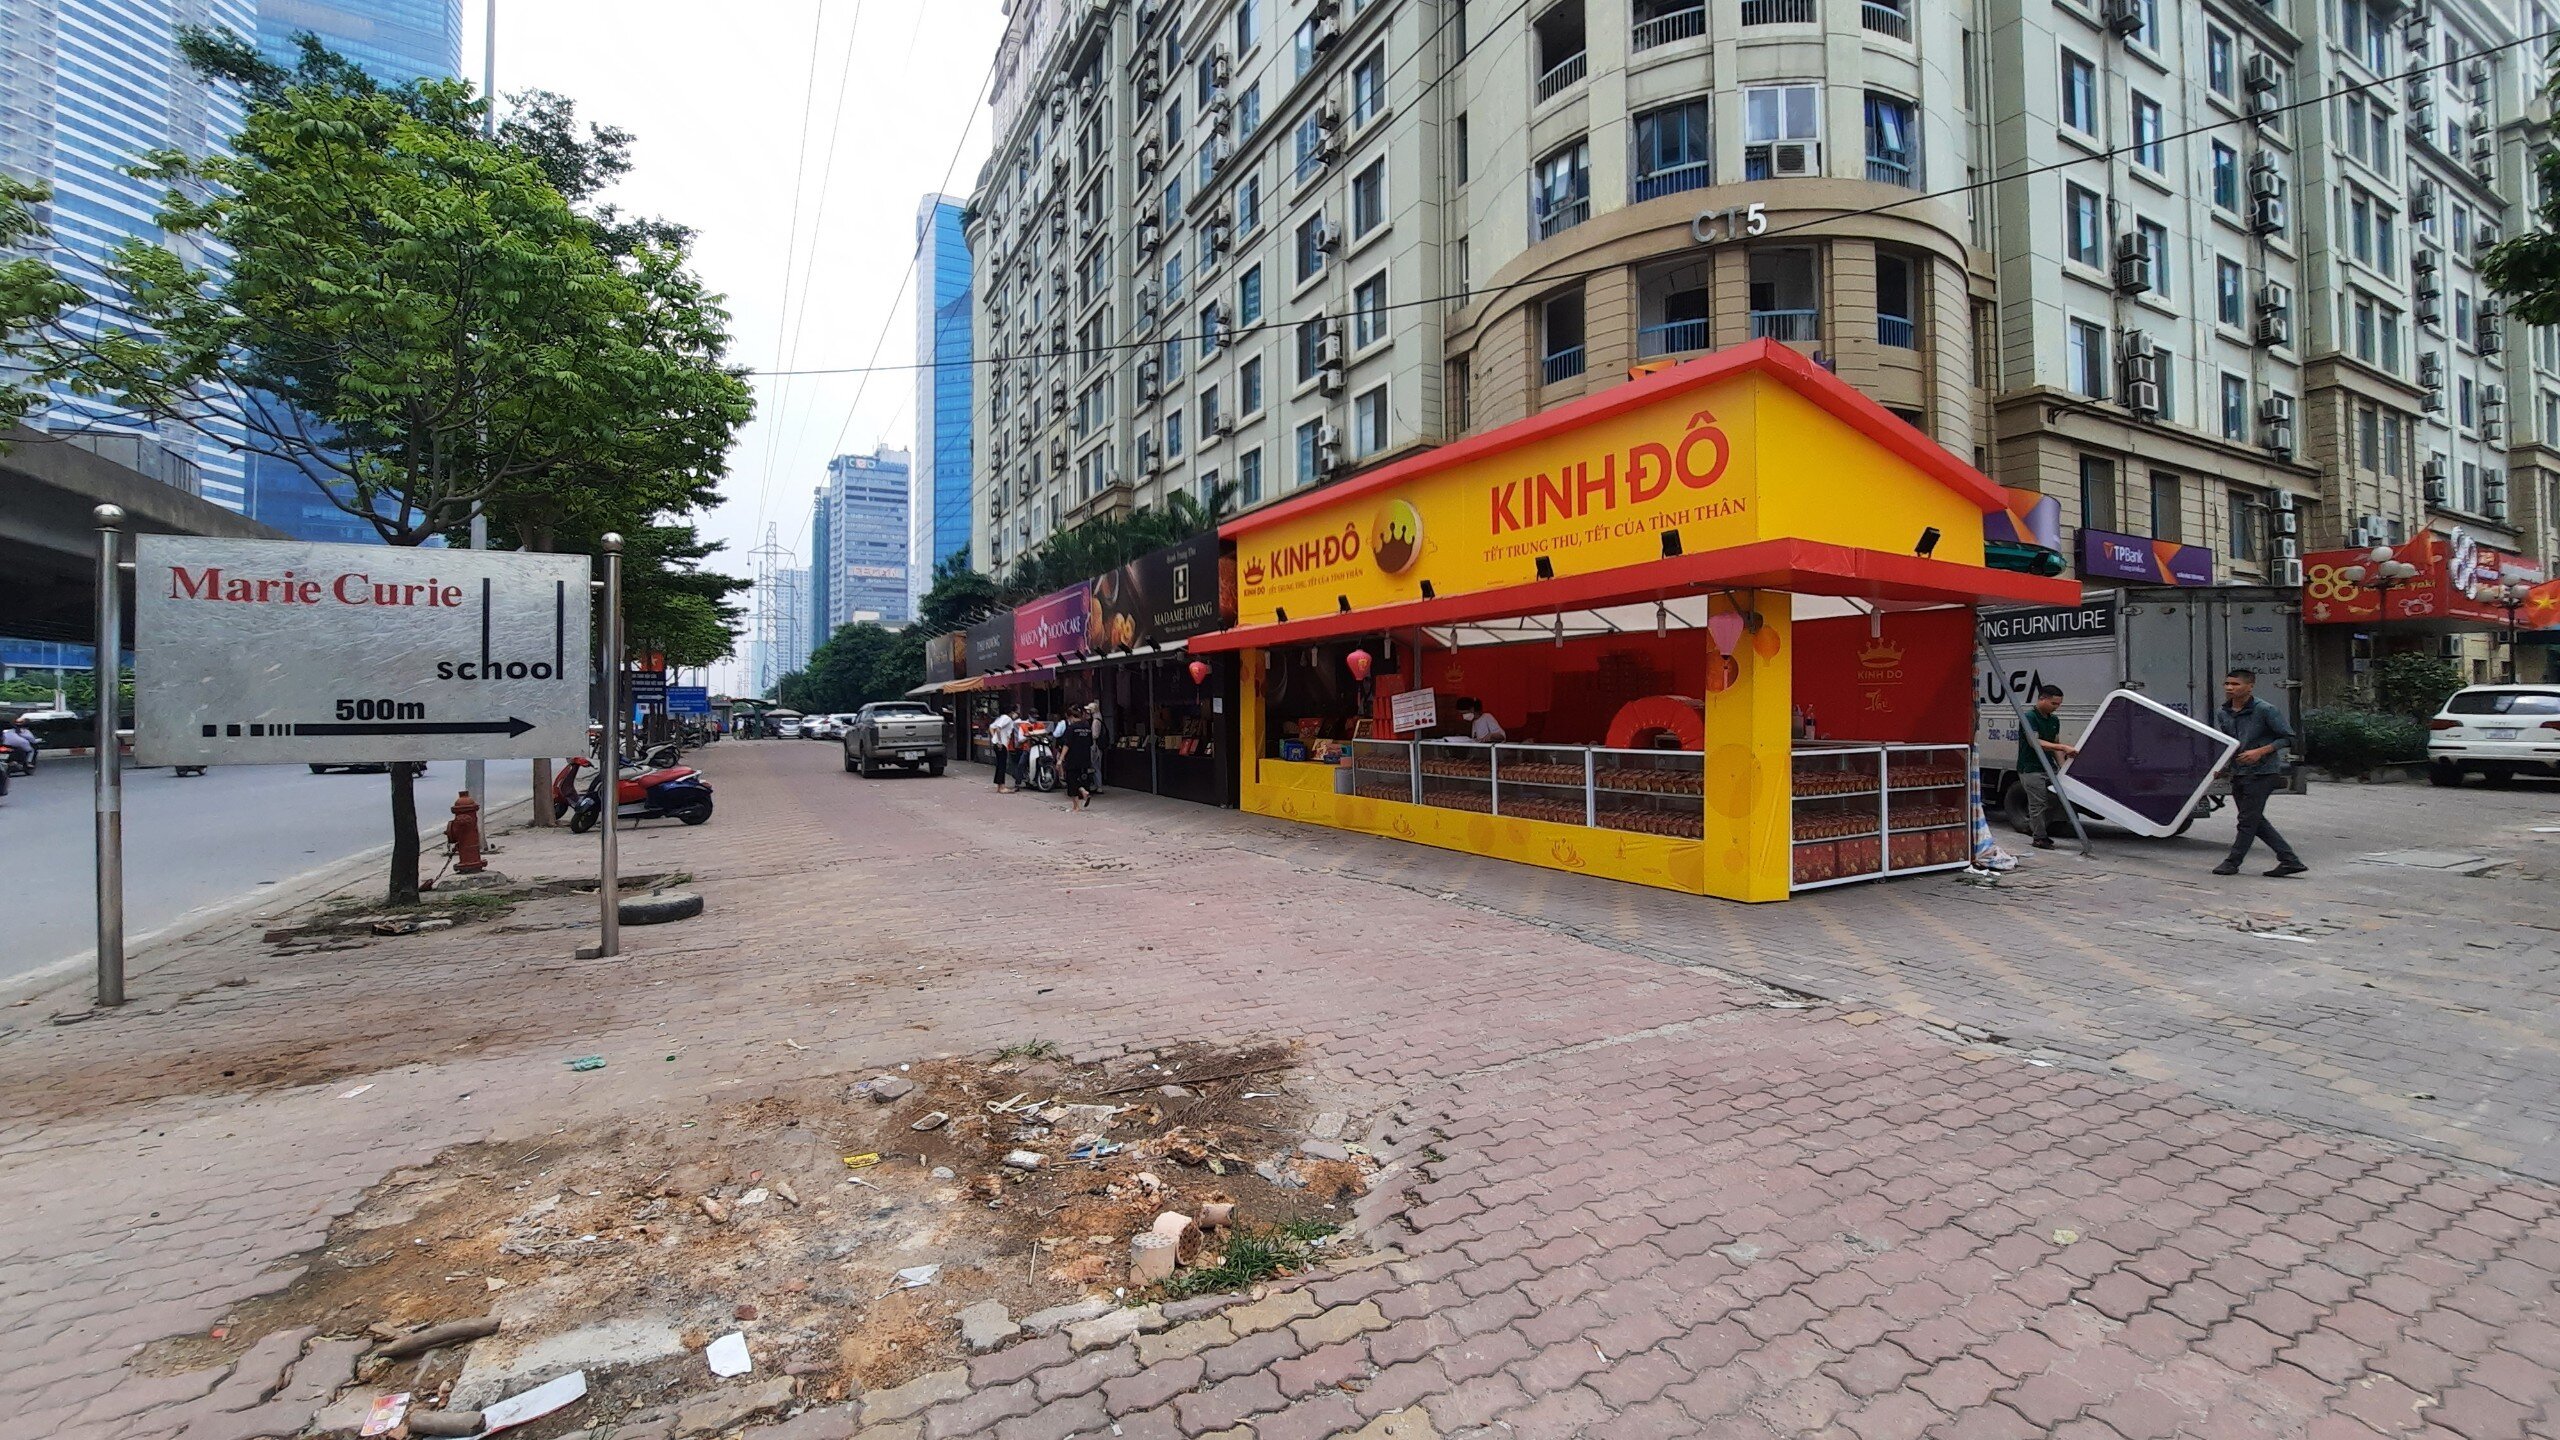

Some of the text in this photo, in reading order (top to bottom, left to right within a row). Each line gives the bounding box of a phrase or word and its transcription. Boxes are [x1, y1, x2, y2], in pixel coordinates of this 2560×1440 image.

[1693, 203, 1767, 242] CT5
[1491, 410, 1730, 535] KINH ĐÔ
[1483, 545, 1505, 563] TẾT
[1506, 539, 1549, 559] TRUNG
[1551, 533, 1583, 552] THU,
[1585, 524, 1611, 544] TẾT
[1649, 510, 1690, 531] TÌNH
[1694, 497, 1747, 521] THÂN
[1271, 522, 1360, 579] KINH ĐÔ
[2114, 545, 2144, 564] TPBank
[168, 566, 463, 608] Marie Curie
[2308, 564, 2359, 602] 88
[437, 578, 564, 680] school
[1153, 608, 1184, 626] MADAME
[2013, 609, 2106, 636] FURNITURE
[1857, 669, 1903, 680] KINH DO
[335, 698, 425, 721] 500m
